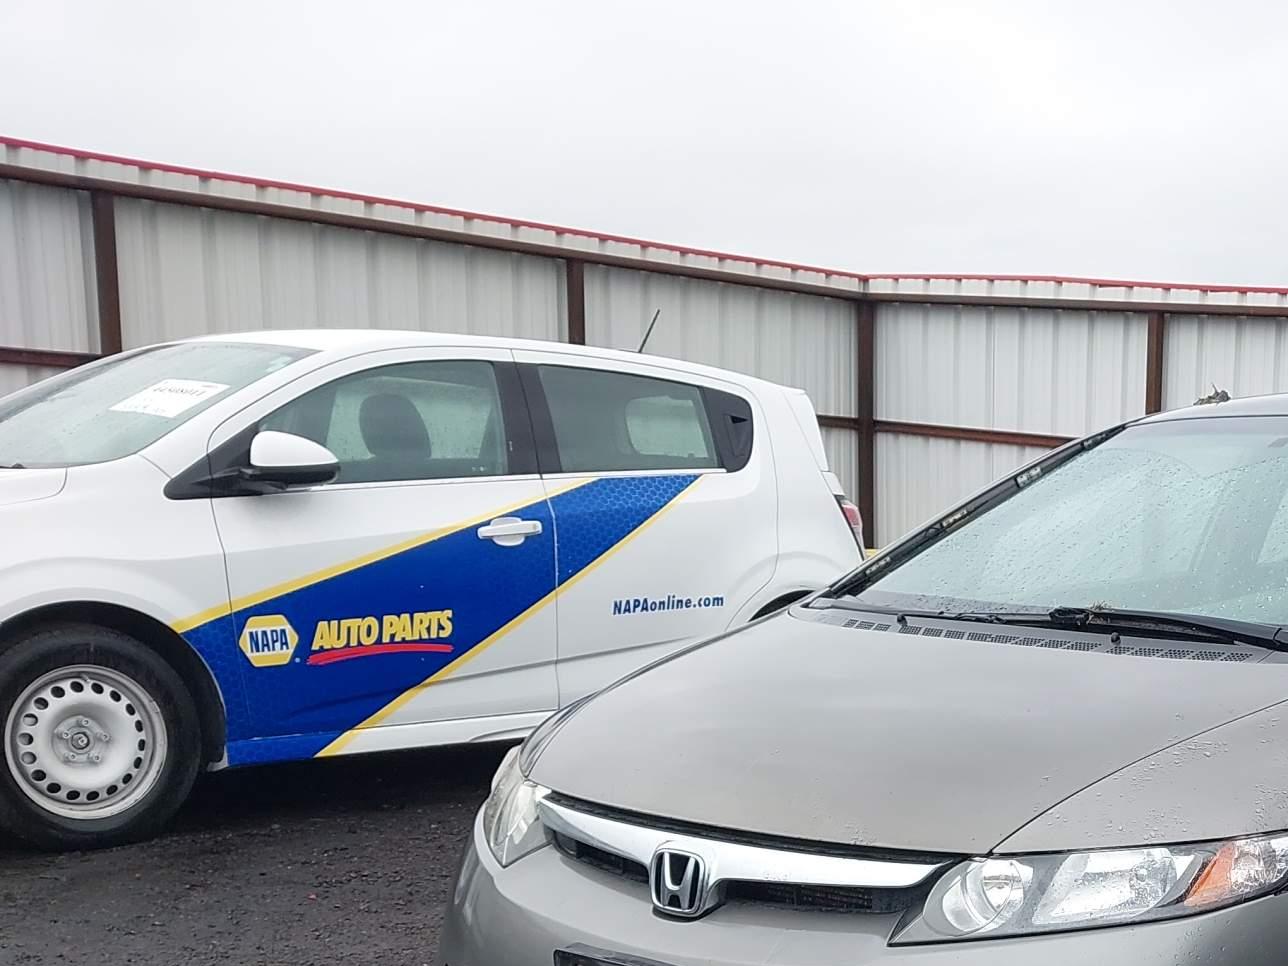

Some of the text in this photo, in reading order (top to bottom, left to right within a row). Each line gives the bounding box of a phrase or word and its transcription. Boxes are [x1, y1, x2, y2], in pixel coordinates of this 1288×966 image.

[612, 595, 725, 615] NAPAonline.com
[248, 609, 453, 653] NAPA AUTO PARTS
